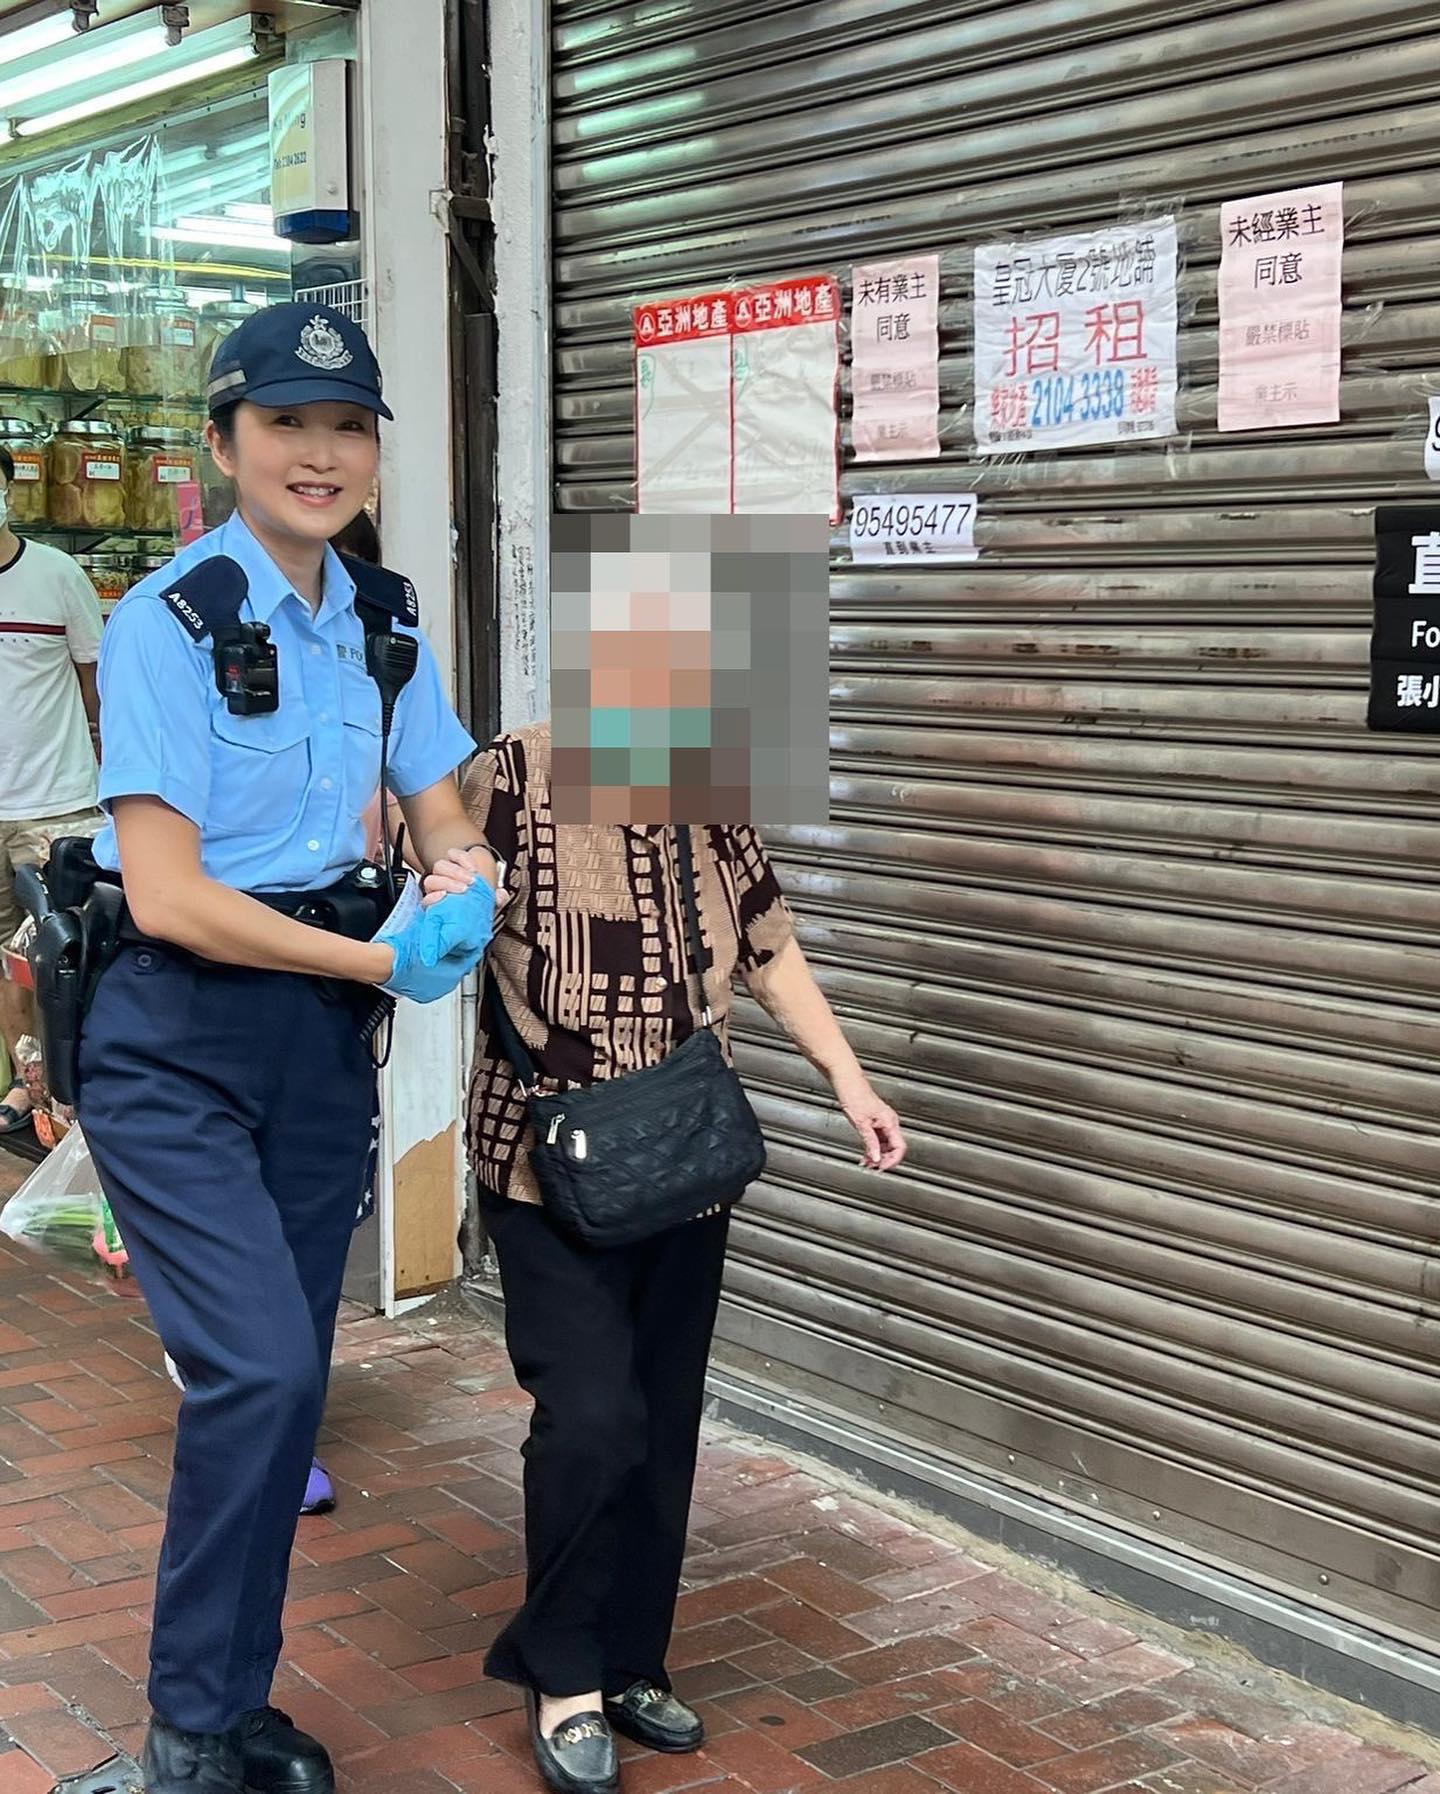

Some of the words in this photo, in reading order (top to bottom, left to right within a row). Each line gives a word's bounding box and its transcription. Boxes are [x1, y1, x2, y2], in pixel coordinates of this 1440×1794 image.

[1228, 204, 1325, 247] 未經業主
[1254, 252, 1303, 288] 同意
[754, 285, 834, 323] 亞洲地產
[858, 272, 927, 307] 未有業主
[657, 299, 728, 337] 亞洲地產
[876, 313, 911, 343] 同意
[1003, 300, 1148, 377] 招租
[1031, 376, 1074, 428] 2104
[1080, 368, 1125, 419] 3338
[854, 503, 972, 538] 95495477
[1408, 531, 1440, 594] 直
[168, 592, 204, 631] A8253
[1411, 620, 1440, 648] Fo
